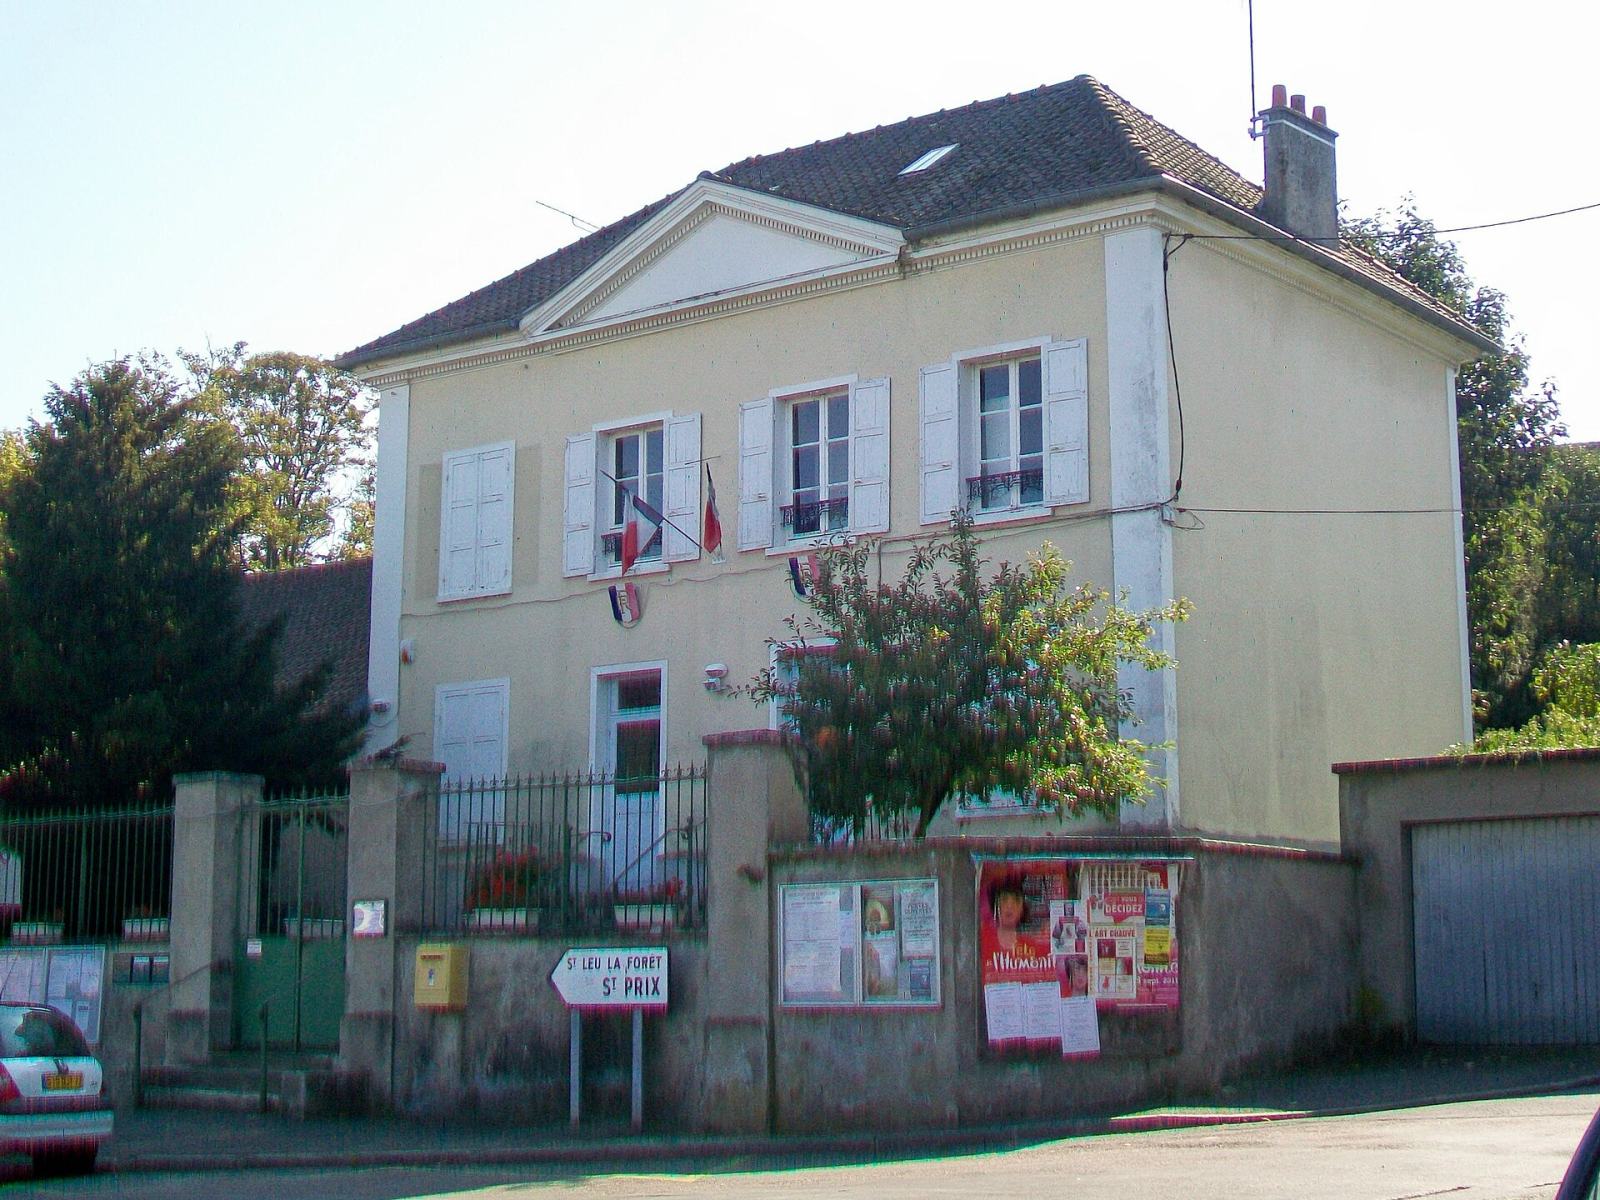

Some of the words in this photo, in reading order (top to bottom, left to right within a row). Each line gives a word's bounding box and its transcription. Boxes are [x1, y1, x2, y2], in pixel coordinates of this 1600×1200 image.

[582, 957, 601, 970] LEU
[608, 956, 621, 970] LA
[625, 976, 661, 997] PRIX
